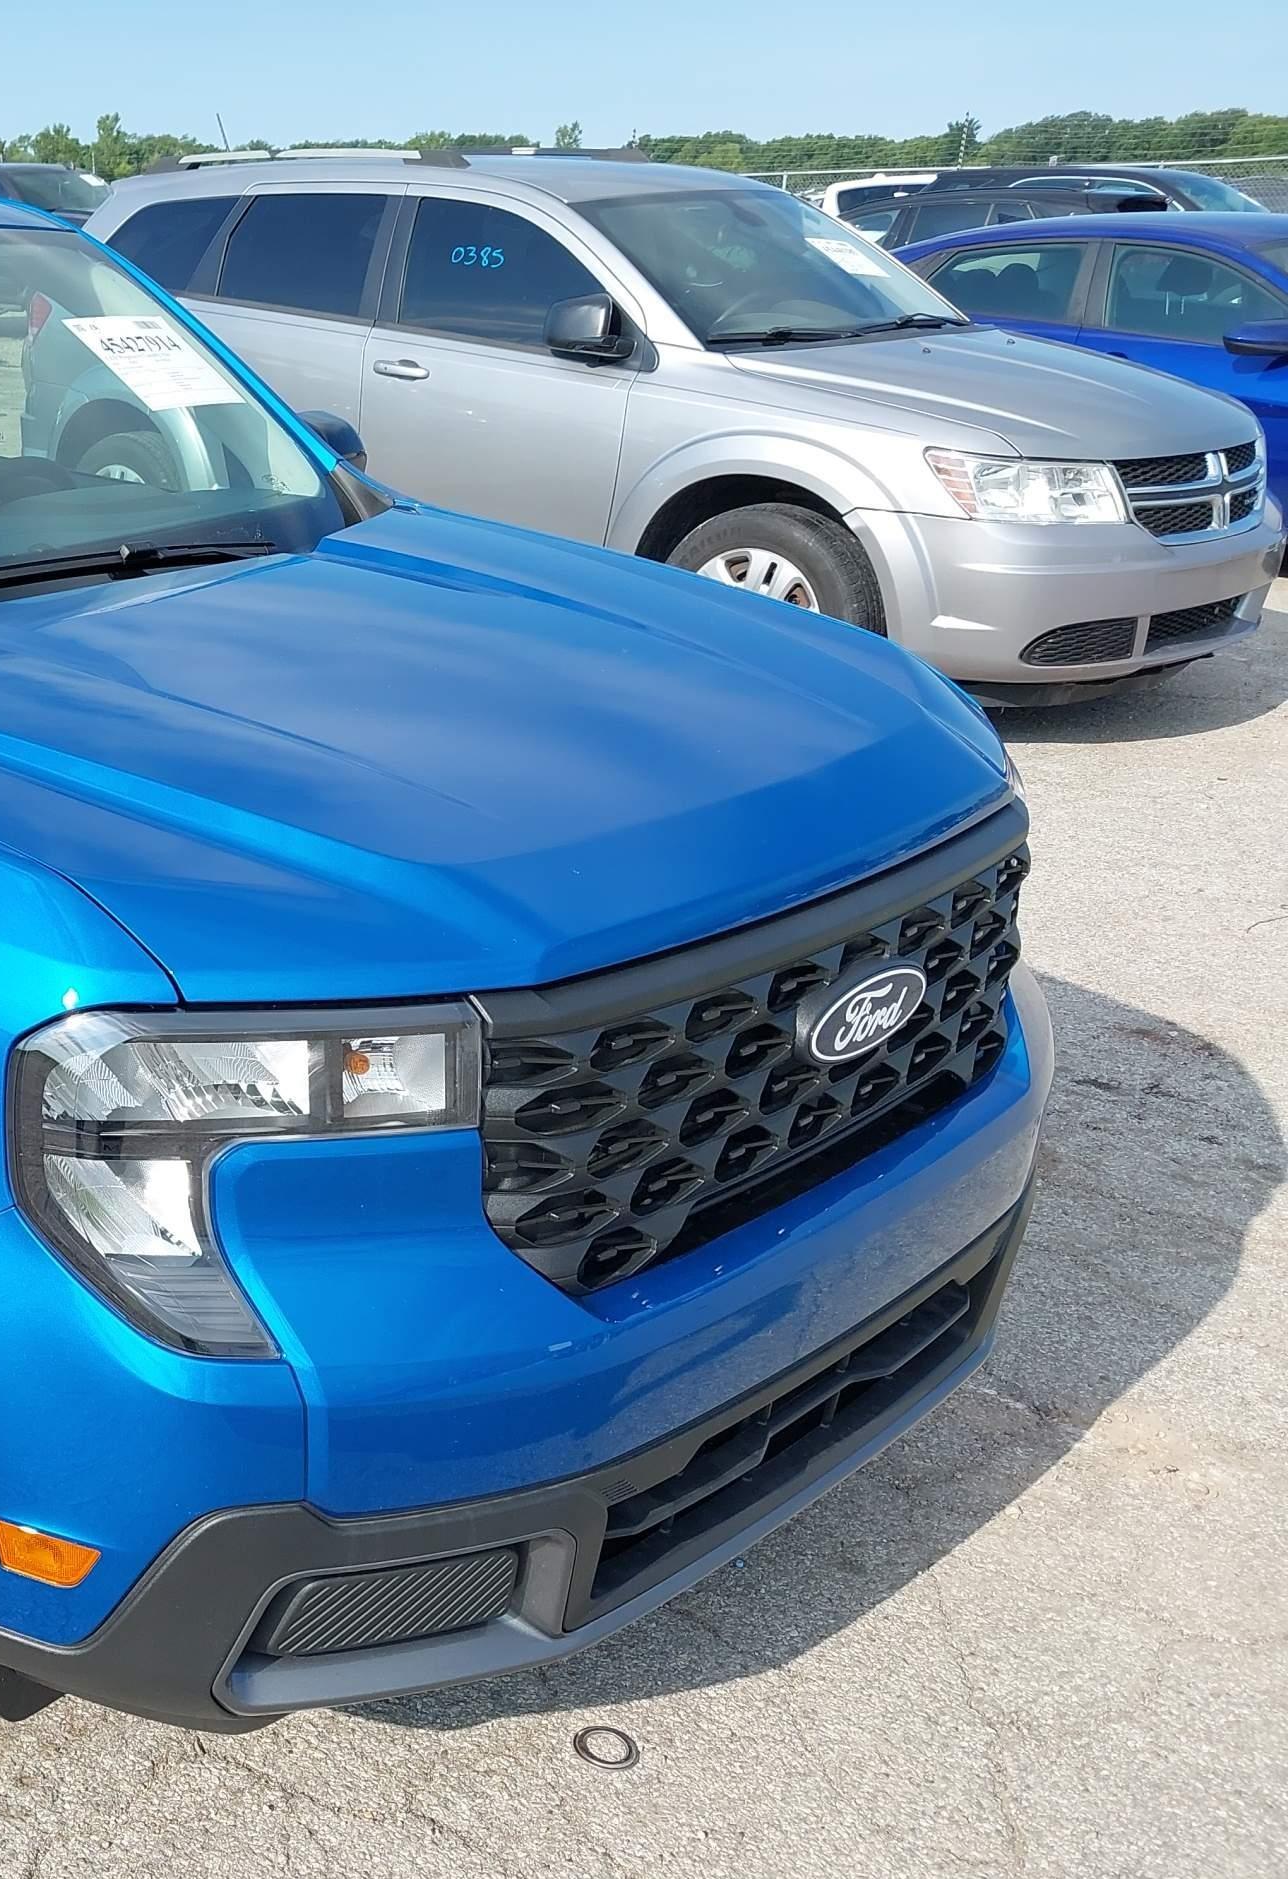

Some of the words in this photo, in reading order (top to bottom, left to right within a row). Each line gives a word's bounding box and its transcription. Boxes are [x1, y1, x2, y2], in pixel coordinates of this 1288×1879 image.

[451, 246, 505, 268] 0385
[99, 334, 183, 355] 45427914
[833, 981, 909, 1052] Ford
